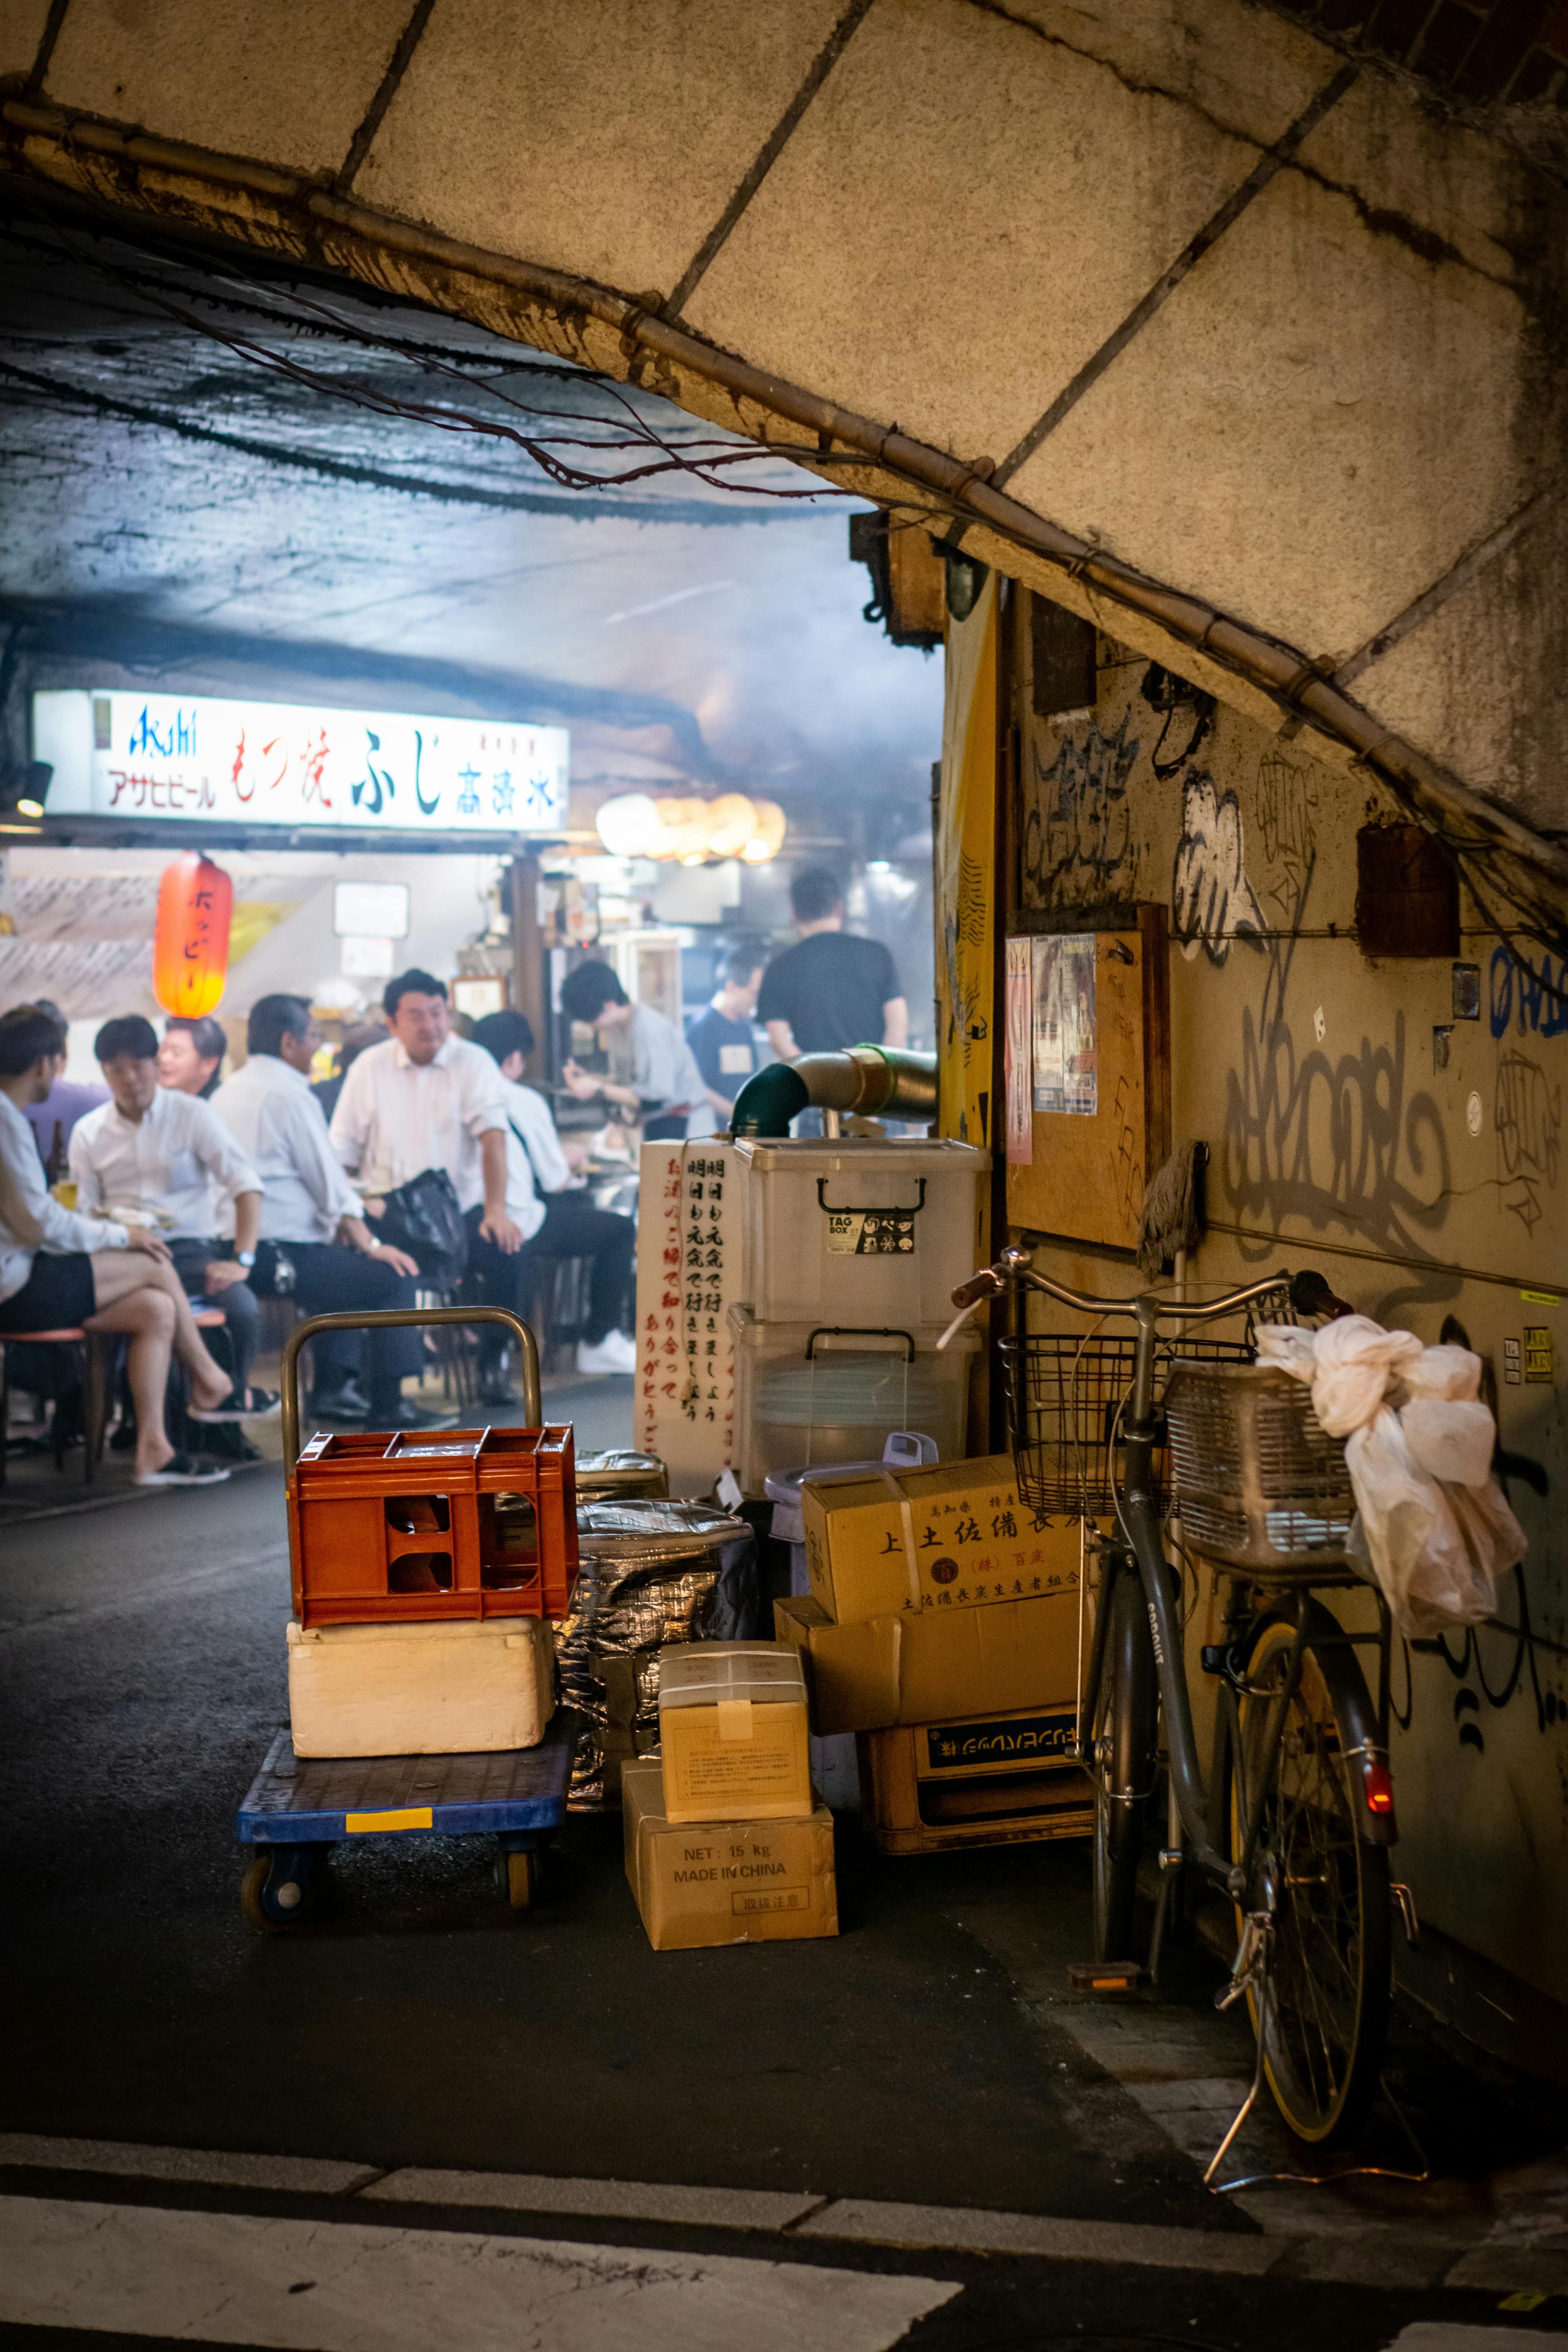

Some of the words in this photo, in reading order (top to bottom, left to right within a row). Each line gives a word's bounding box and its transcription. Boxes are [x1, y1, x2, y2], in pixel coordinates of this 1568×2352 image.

[129, 704, 196, 757] Asahi
[109, 770, 216, 809] アサヒビール
[829, 1216, 853, 1227] TAG
[730, 1845, 744, 1858] 15
[753, 1844, 771, 1858] kg
[674, 1867, 717, 1883] MADE
[722, 1866, 737, 1879] IN
[740, 1862, 786, 1878] CHINA
